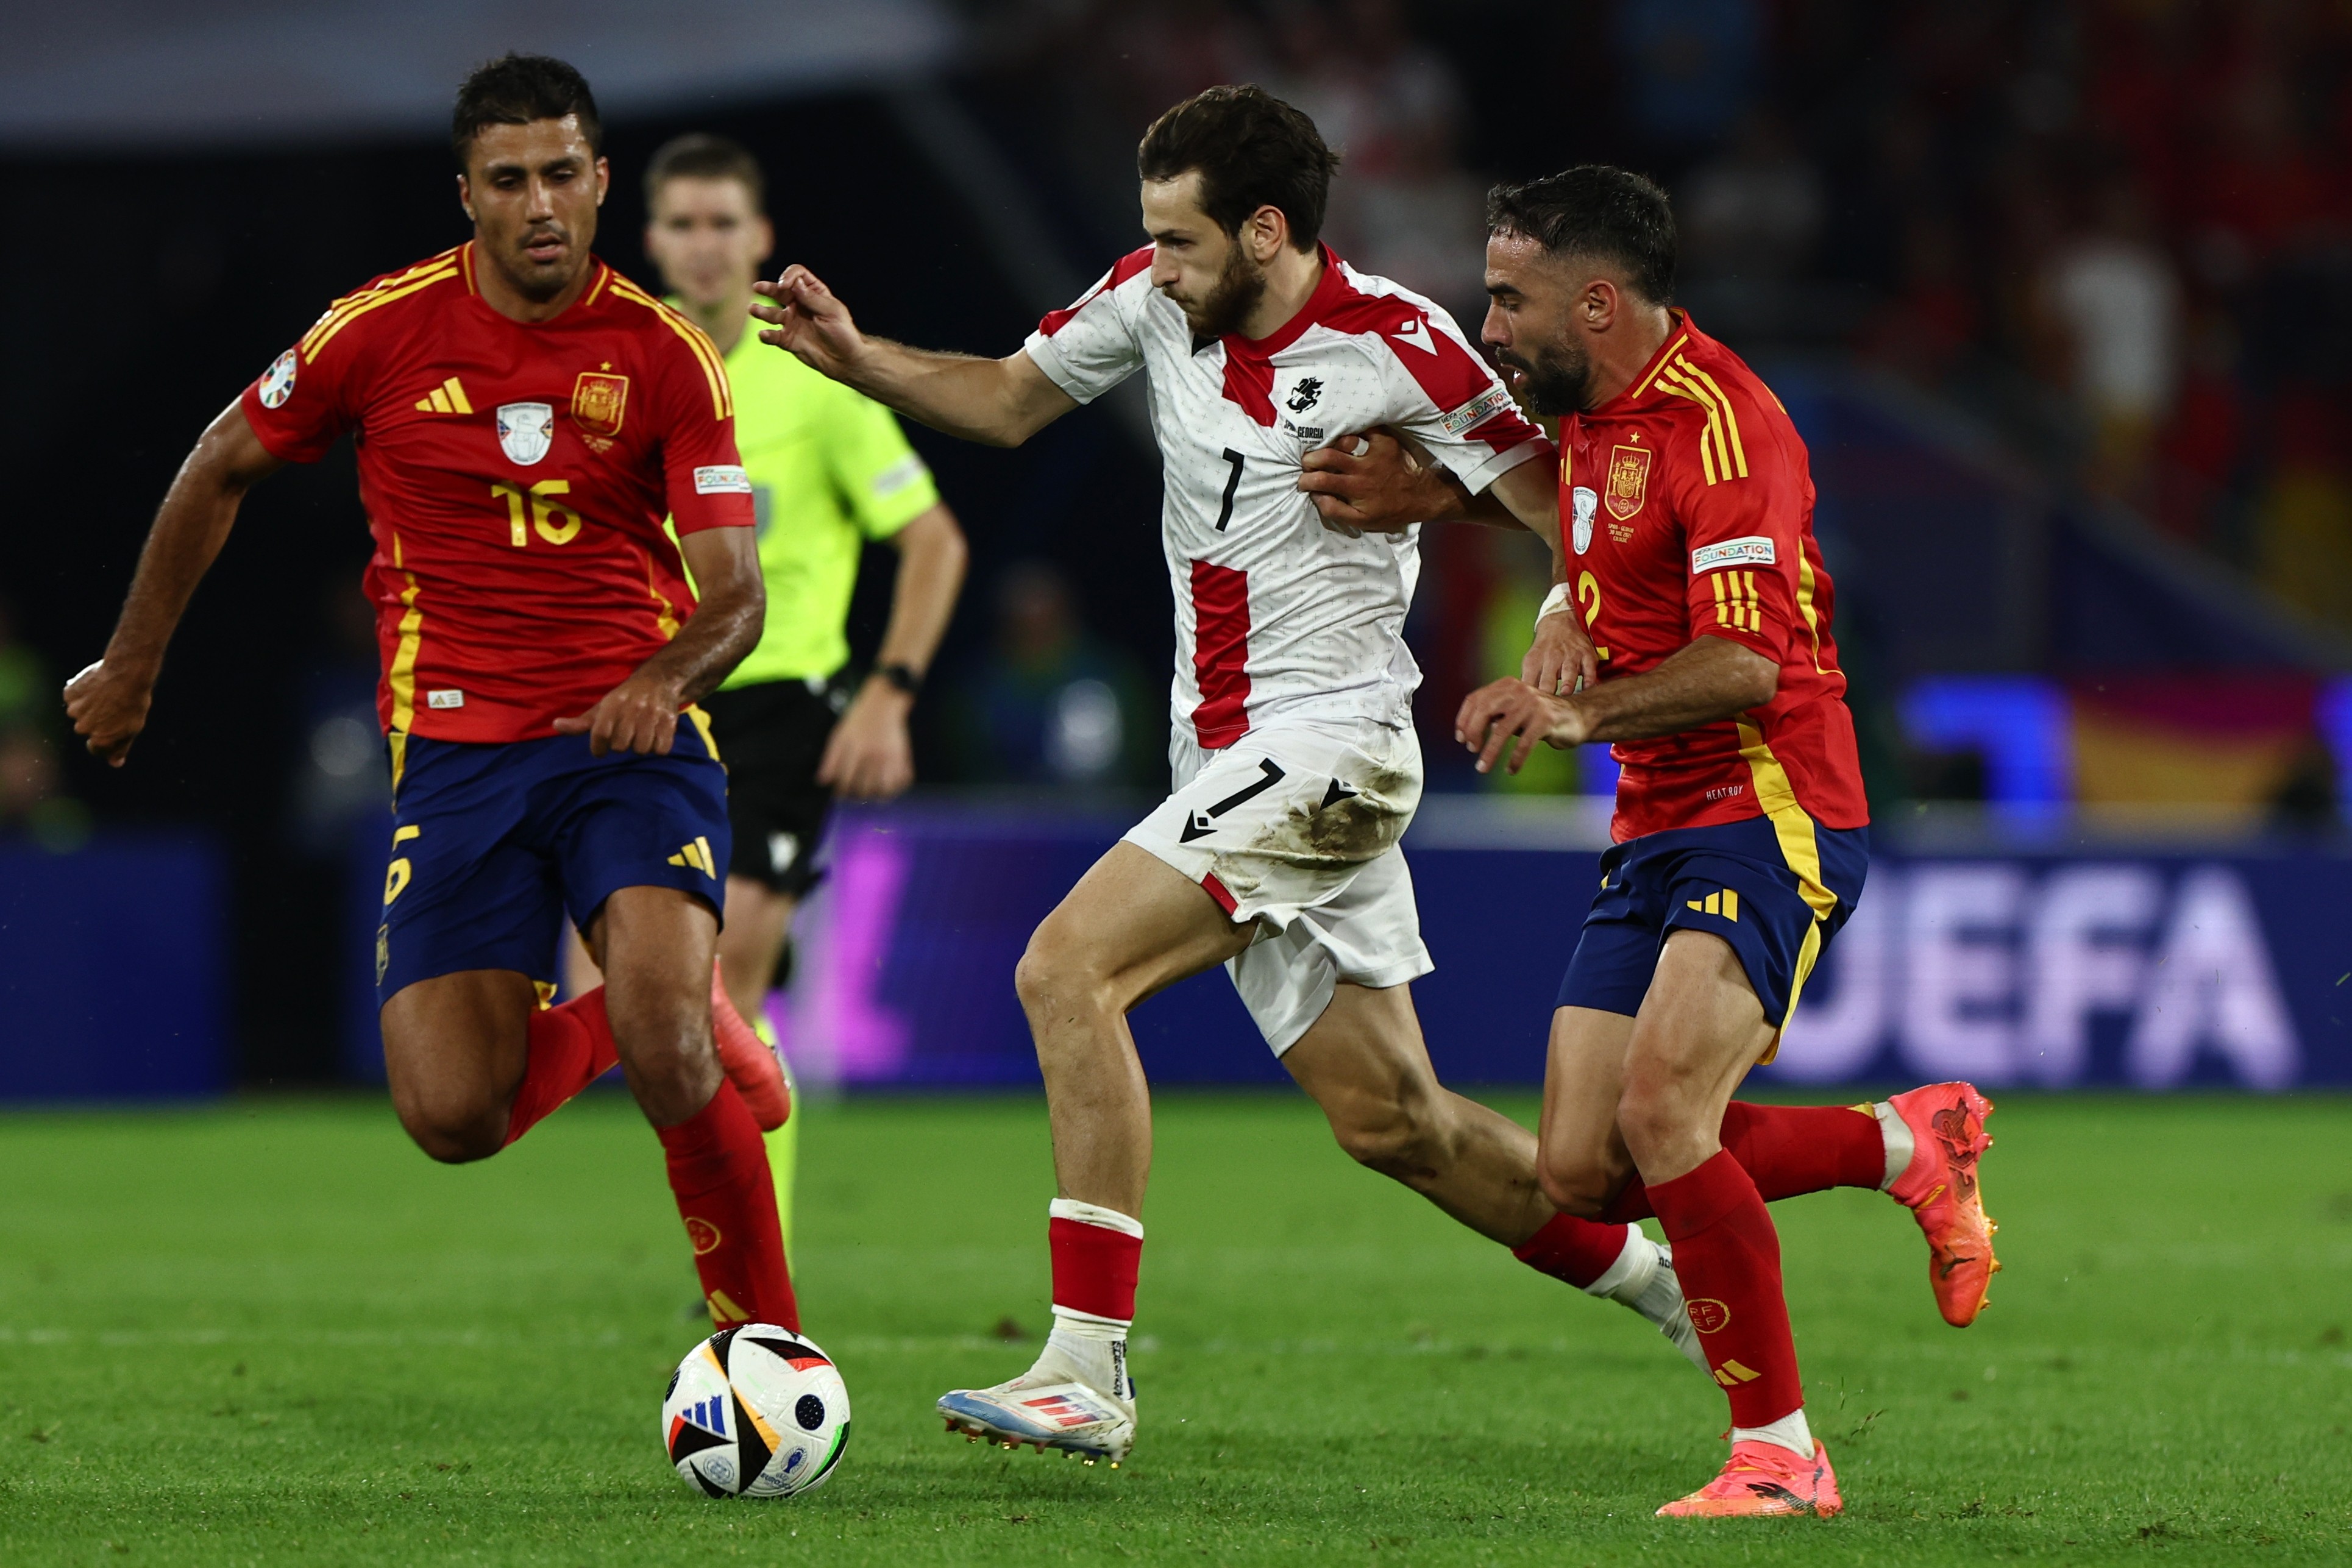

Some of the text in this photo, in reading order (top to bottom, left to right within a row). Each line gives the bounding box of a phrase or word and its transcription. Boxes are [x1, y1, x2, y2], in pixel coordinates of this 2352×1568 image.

[1441, 412, 1457, 423] UEFA
[1444, 391, 1509, 432] FOUNDATION
[1298, 426, 1324, 439] GEORGIA
[1215, 447, 1245, 531] 7
[491, 480, 581, 547] 16
[1695, 545, 1772, 564] FOUNDATION
[1206, 757, 1286, 818] 7
